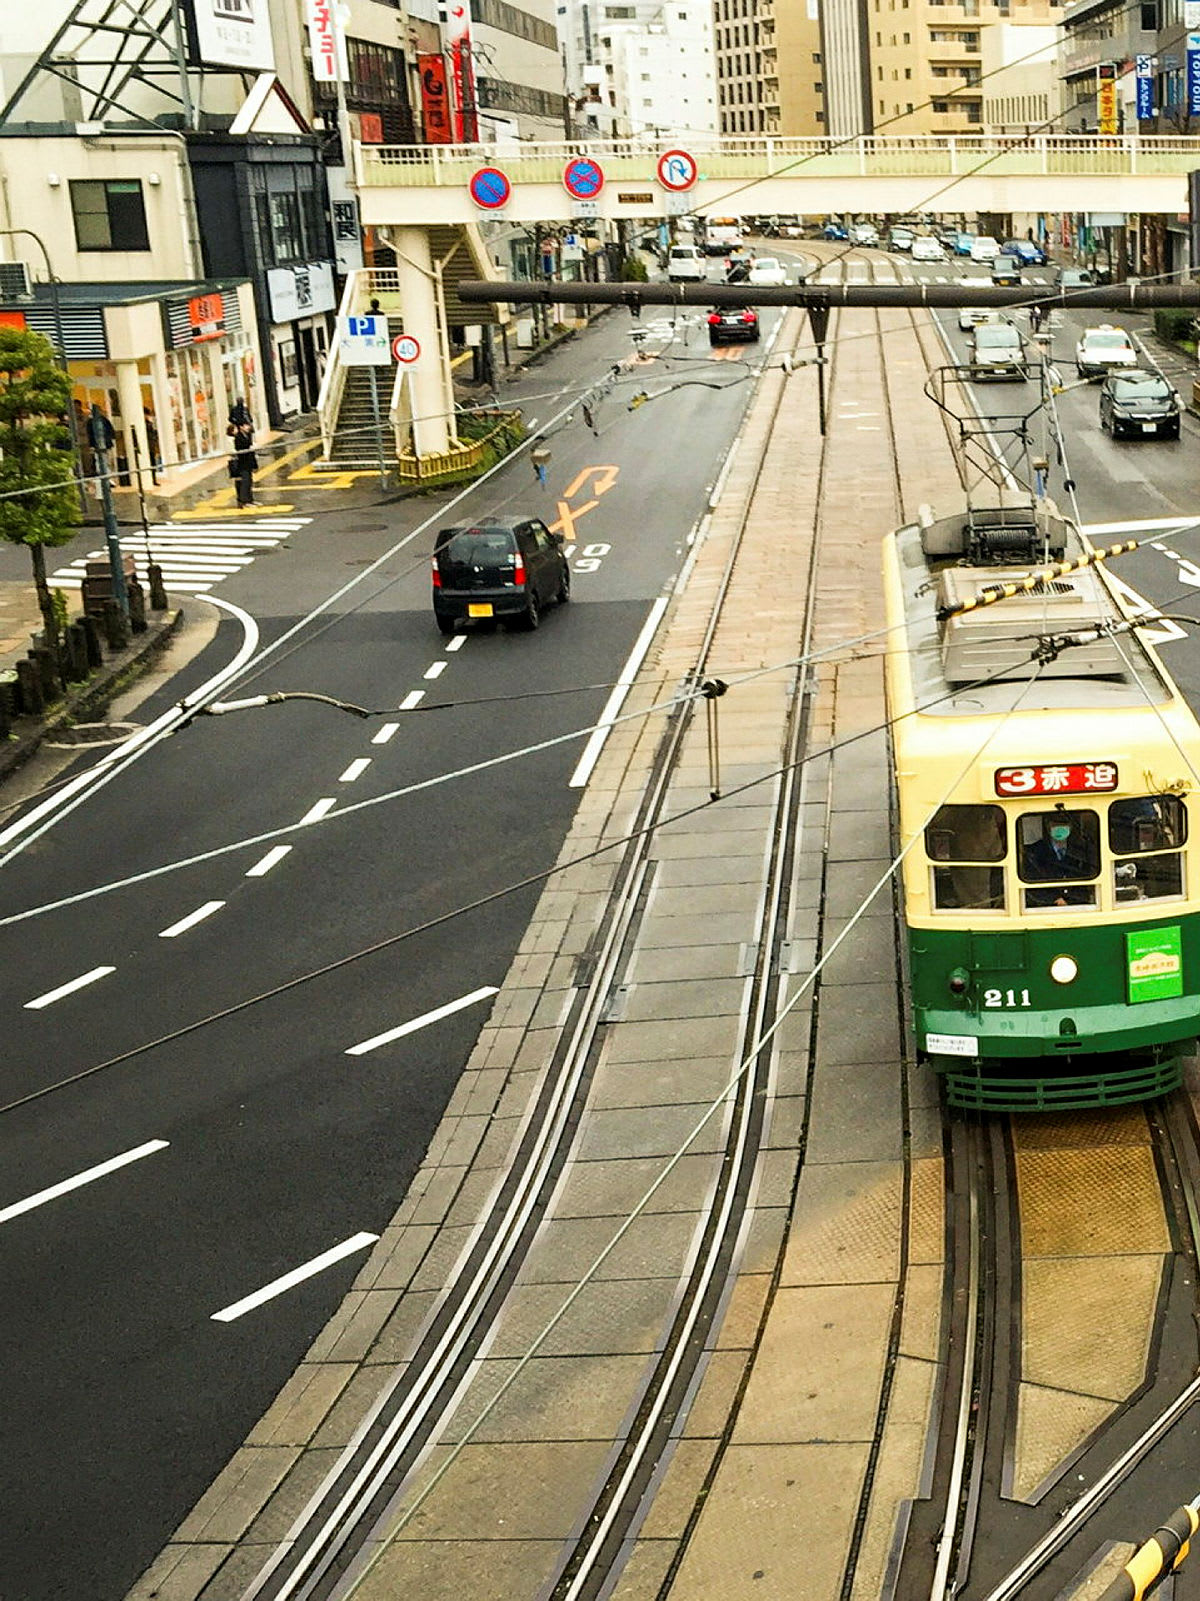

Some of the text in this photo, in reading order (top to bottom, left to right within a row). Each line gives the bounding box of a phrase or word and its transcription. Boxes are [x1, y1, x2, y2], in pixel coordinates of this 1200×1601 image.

[356, 317, 369, 335] P
[999, 765, 1116, 792] 3 赤迫
[984, 989, 1031, 1007] 211
